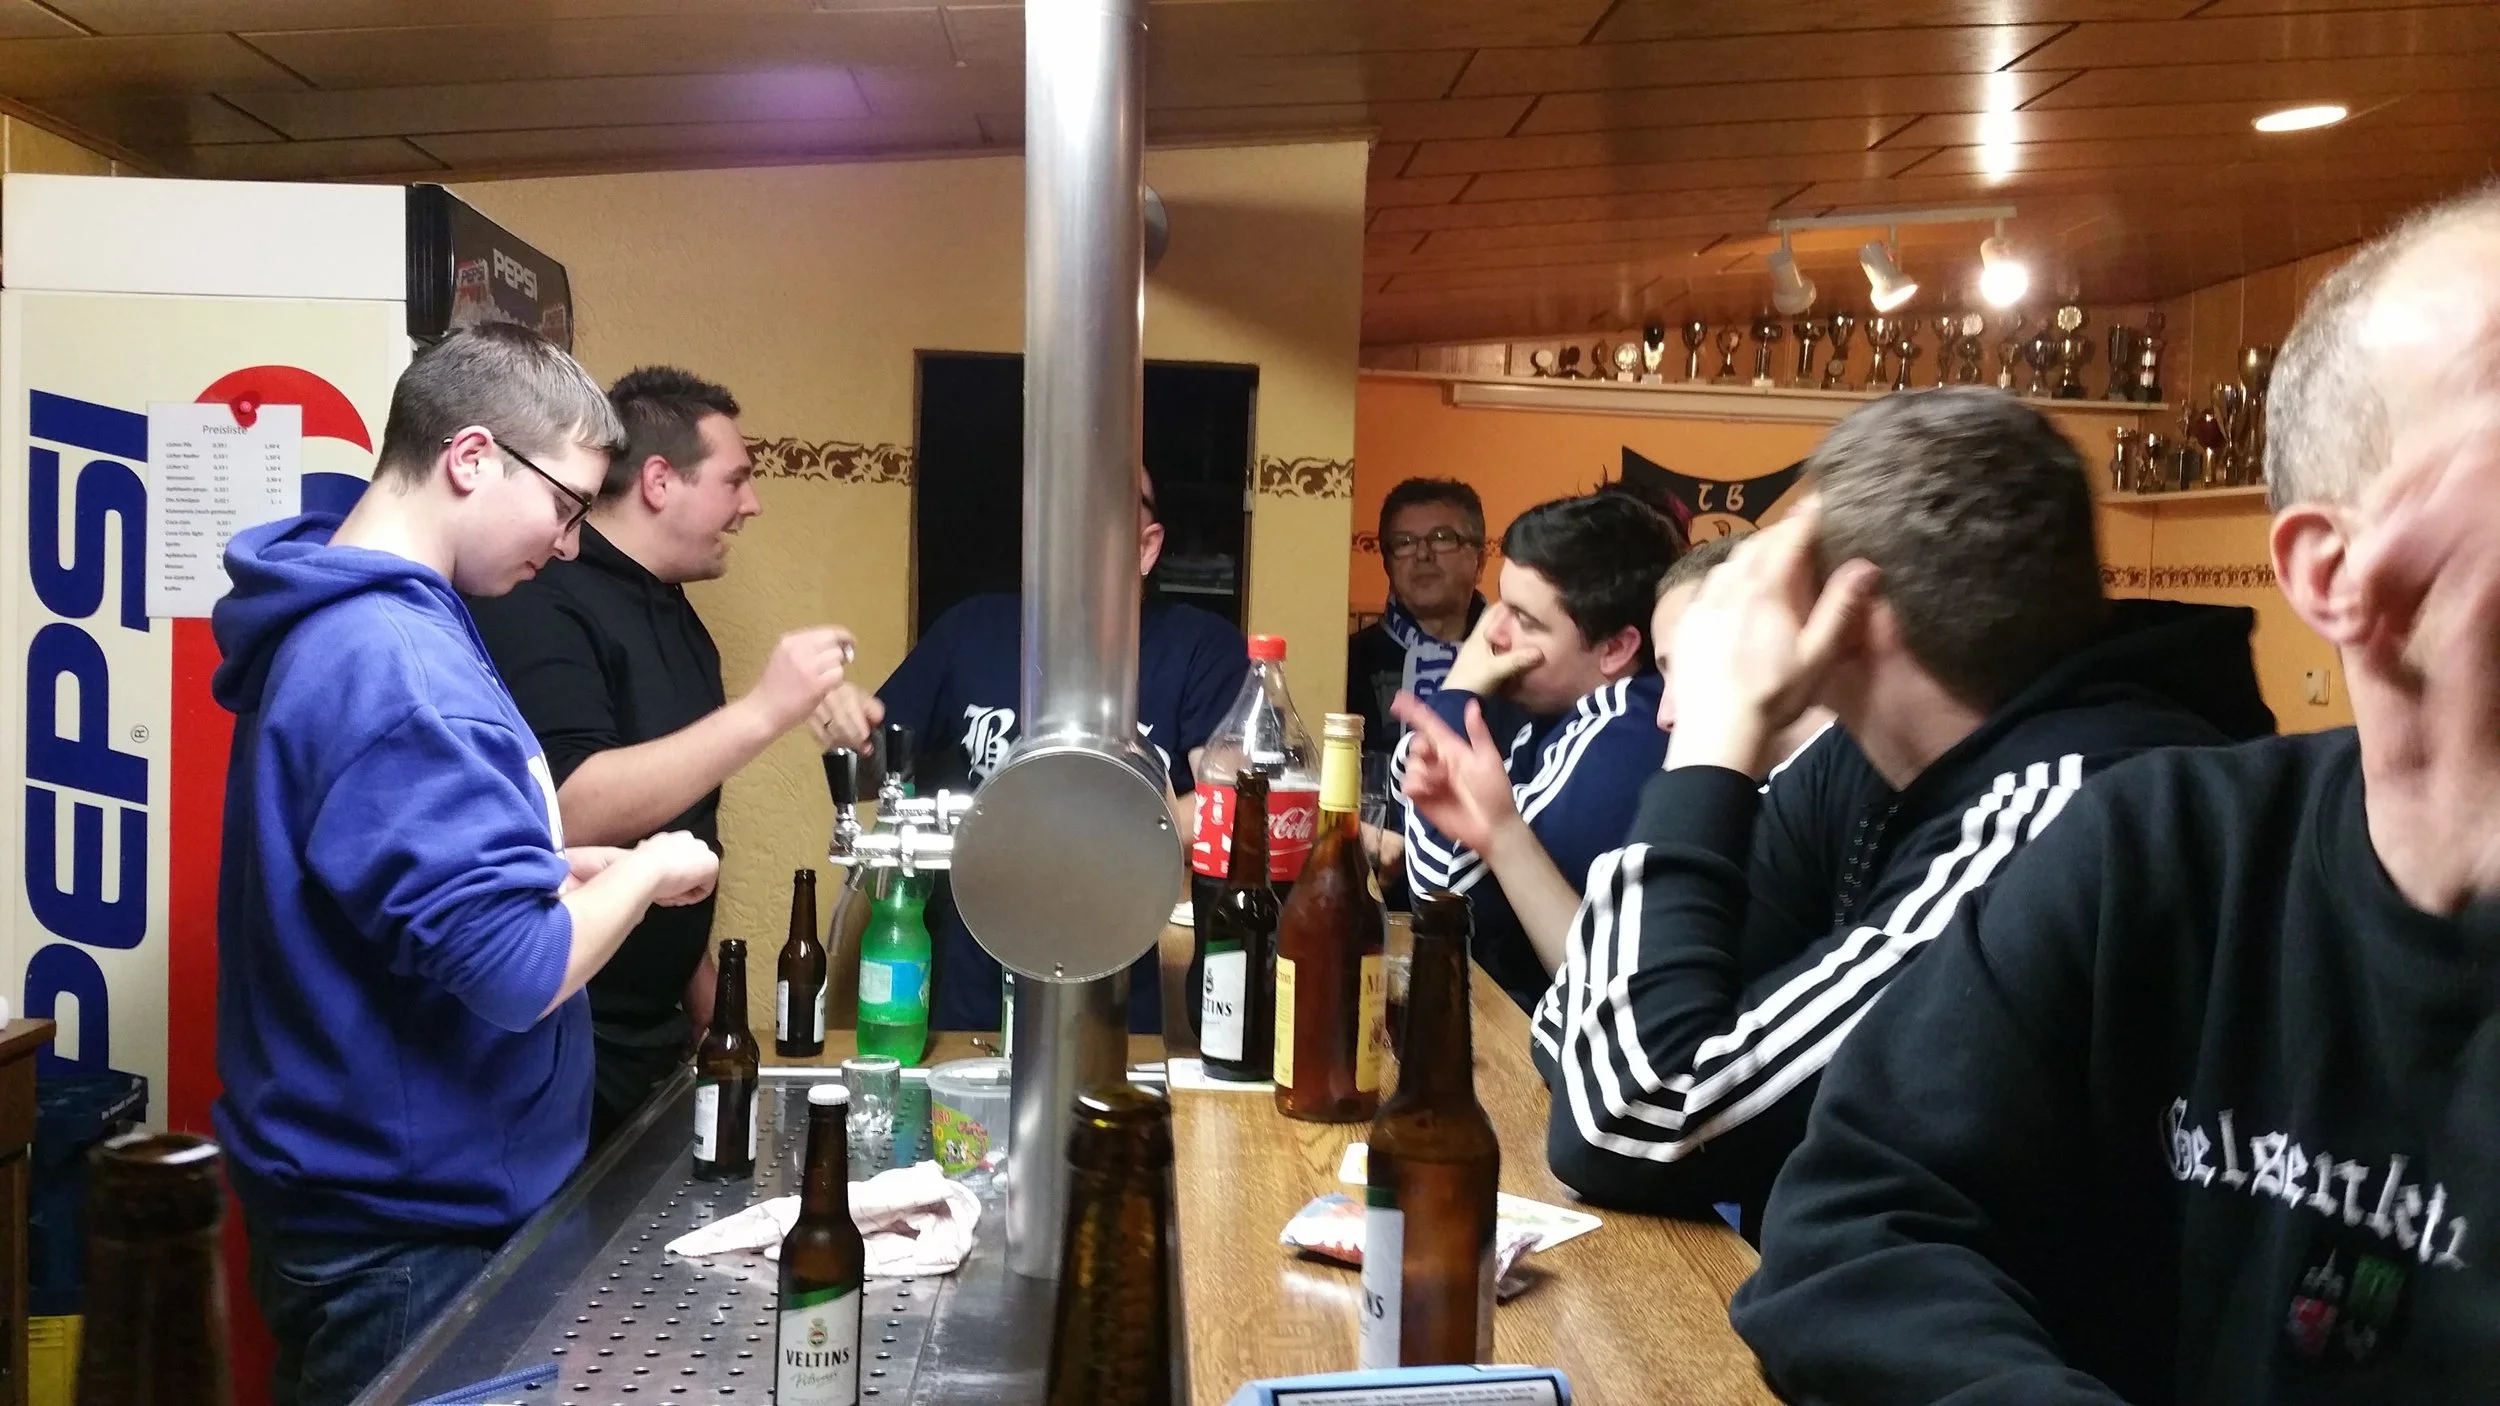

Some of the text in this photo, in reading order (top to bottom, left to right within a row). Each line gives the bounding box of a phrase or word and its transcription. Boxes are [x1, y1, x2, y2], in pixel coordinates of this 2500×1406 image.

[493, 247, 538, 301] PEPSI
[202, 424, 248, 435] Preisliste
[25, 387, 149, 1080] PEPSI
[1202, 995, 1233, 1018] LTINS
[785, 1346, 850, 1369] VELTINS
